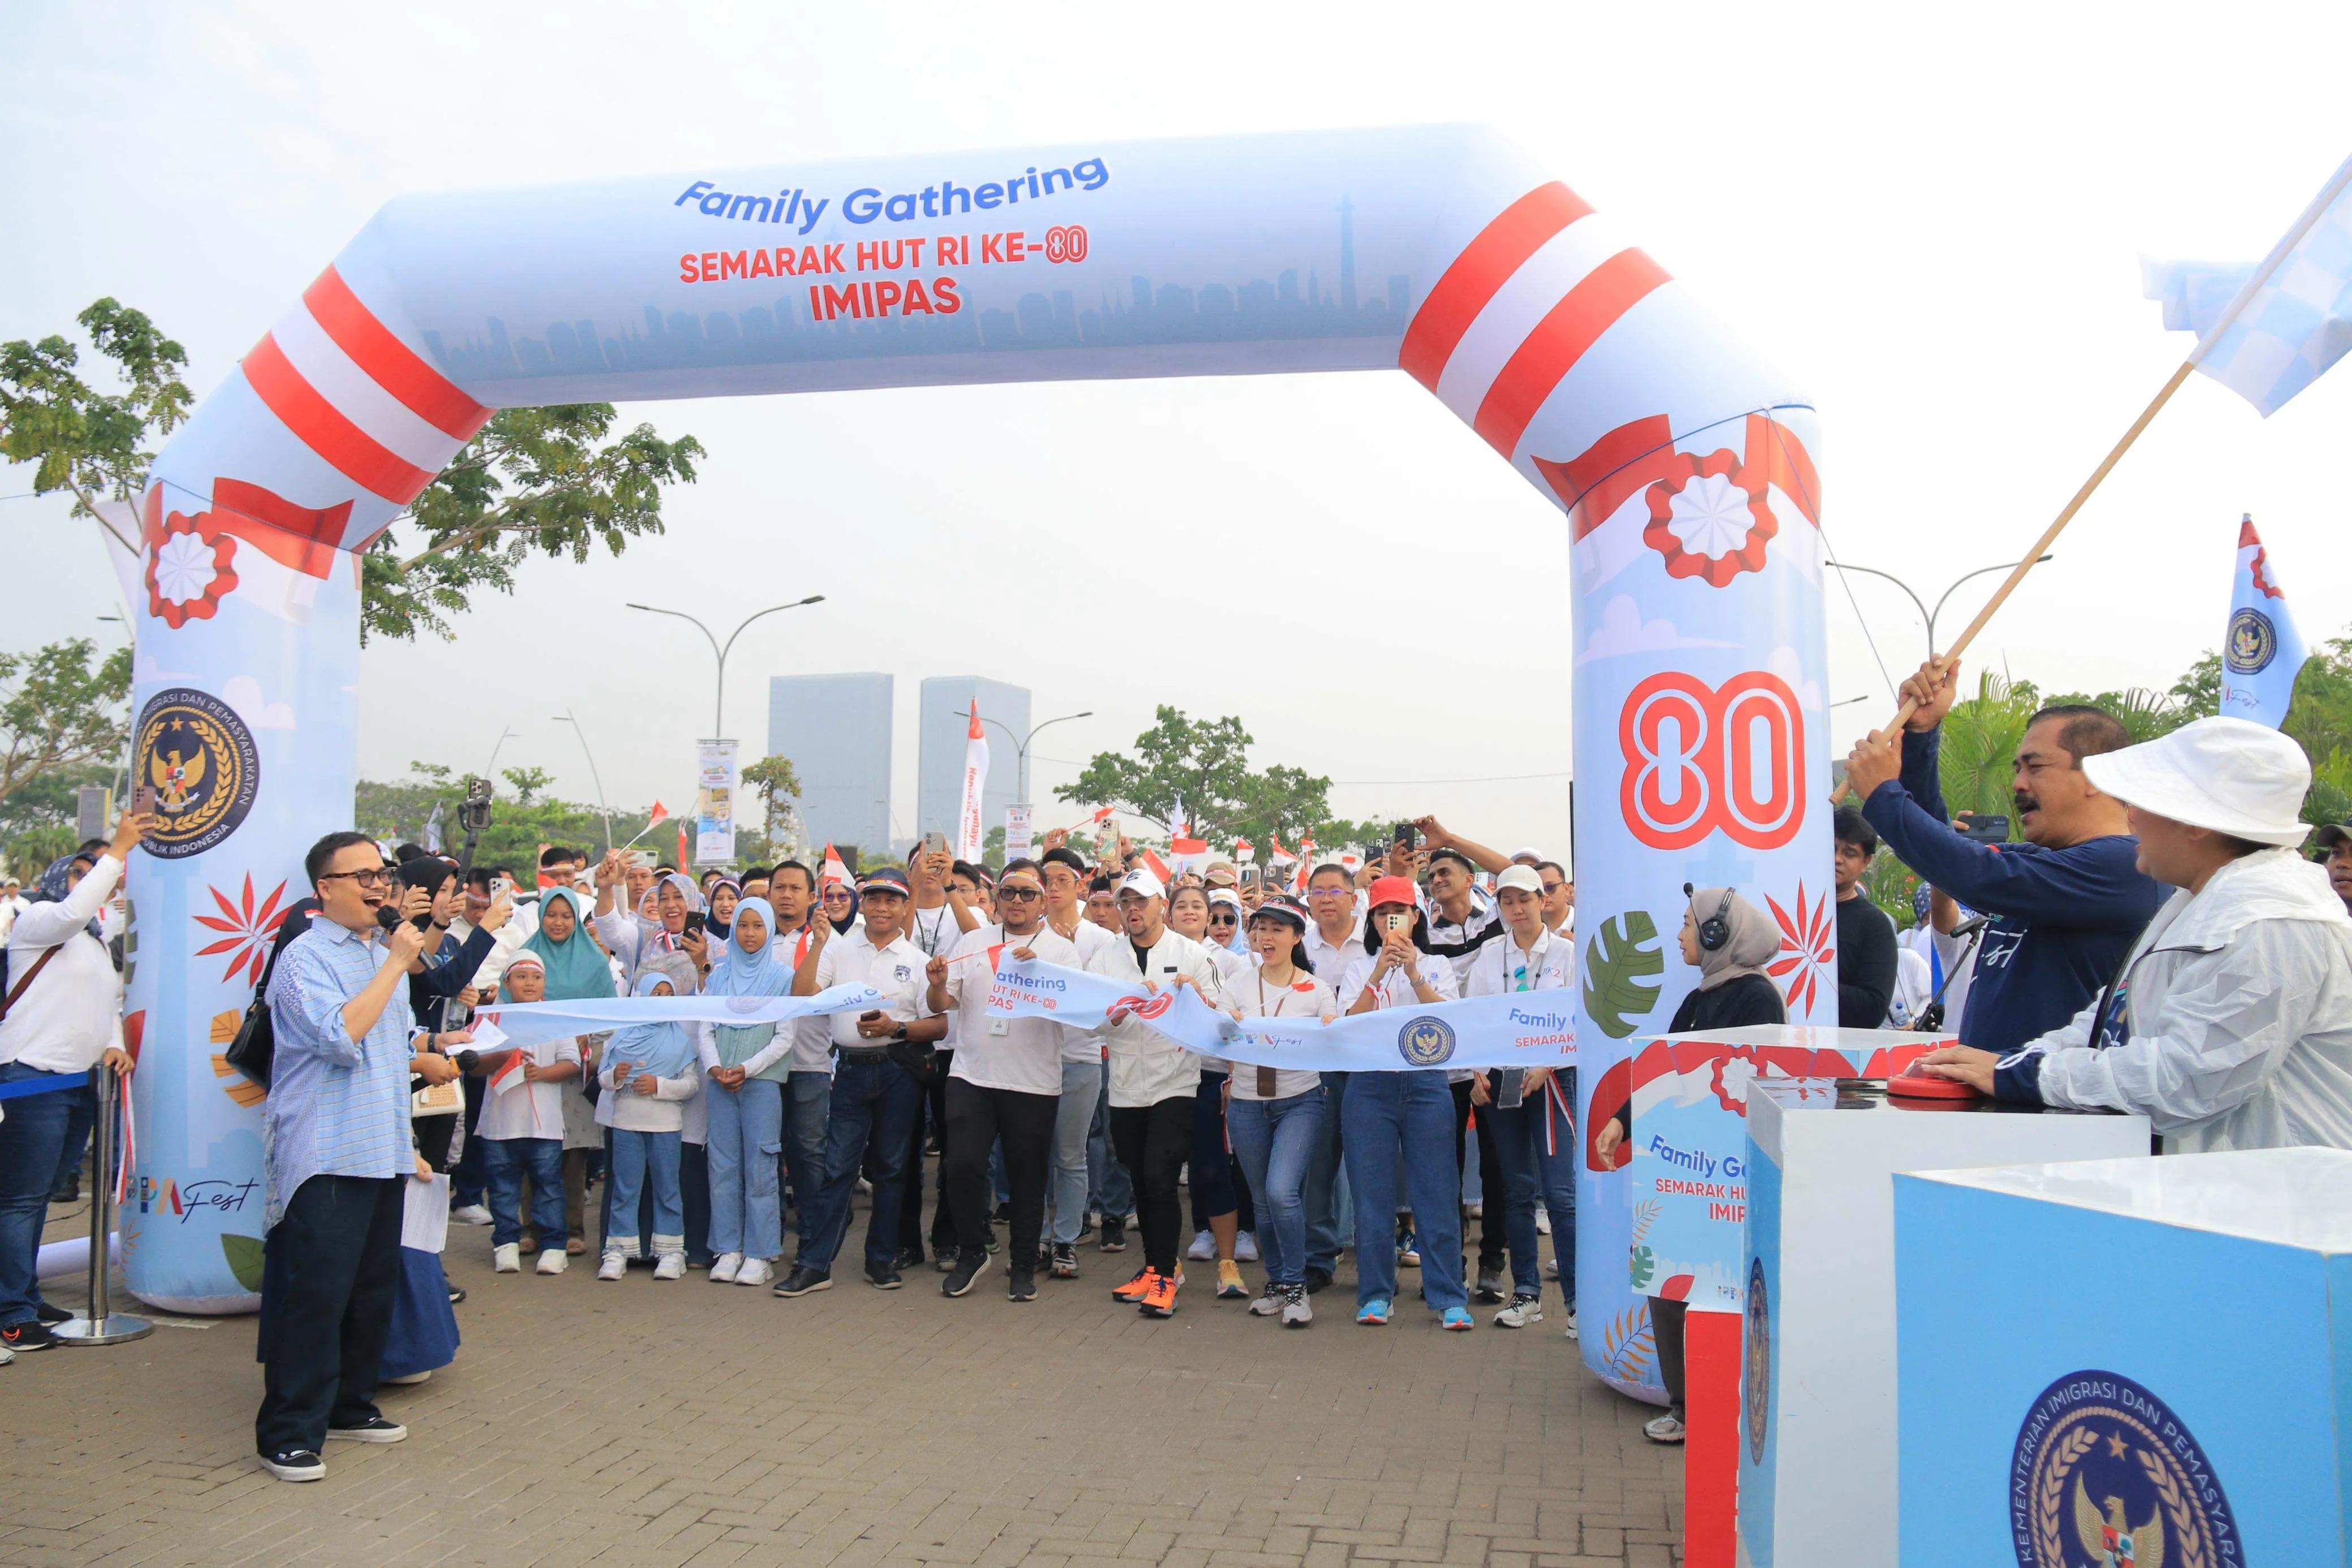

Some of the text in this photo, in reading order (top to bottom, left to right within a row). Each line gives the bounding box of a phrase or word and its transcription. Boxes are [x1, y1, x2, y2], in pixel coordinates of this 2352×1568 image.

[674, 157, 1110, 235] Family Gathering
[680, 224, 1088, 284] SEMARAK HUT RI KE-80
[809, 277, 961, 321] IMIPAS
[180, 693, 206, 707] DAN
[207, 701, 254, 805] PEMASYARAKATAN
[1619, 670, 1806, 850] 80
[170, 823, 231, 855] INDONESIA
[988, 995, 1013, 1010] PAS
[993, 984, 1057, 1010] UT RI KE-80
[996, 972, 1066, 992] athering
[1508, 1007, 1567, 1032] Family
[1515, 1033, 1575, 1047] SEMARAK
[1649, 1134, 1717, 1179] Family
[181, 1177, 260, 1224] Fest
[1655, 1178, 1726, 1198] SEMARAK
[2014, 1406, 2051, 1562] KEMENTERIAN
[2048, 1381, 2117, 1414] IMIGRASI
[2122, 1387, 2161, 1426] DAN
